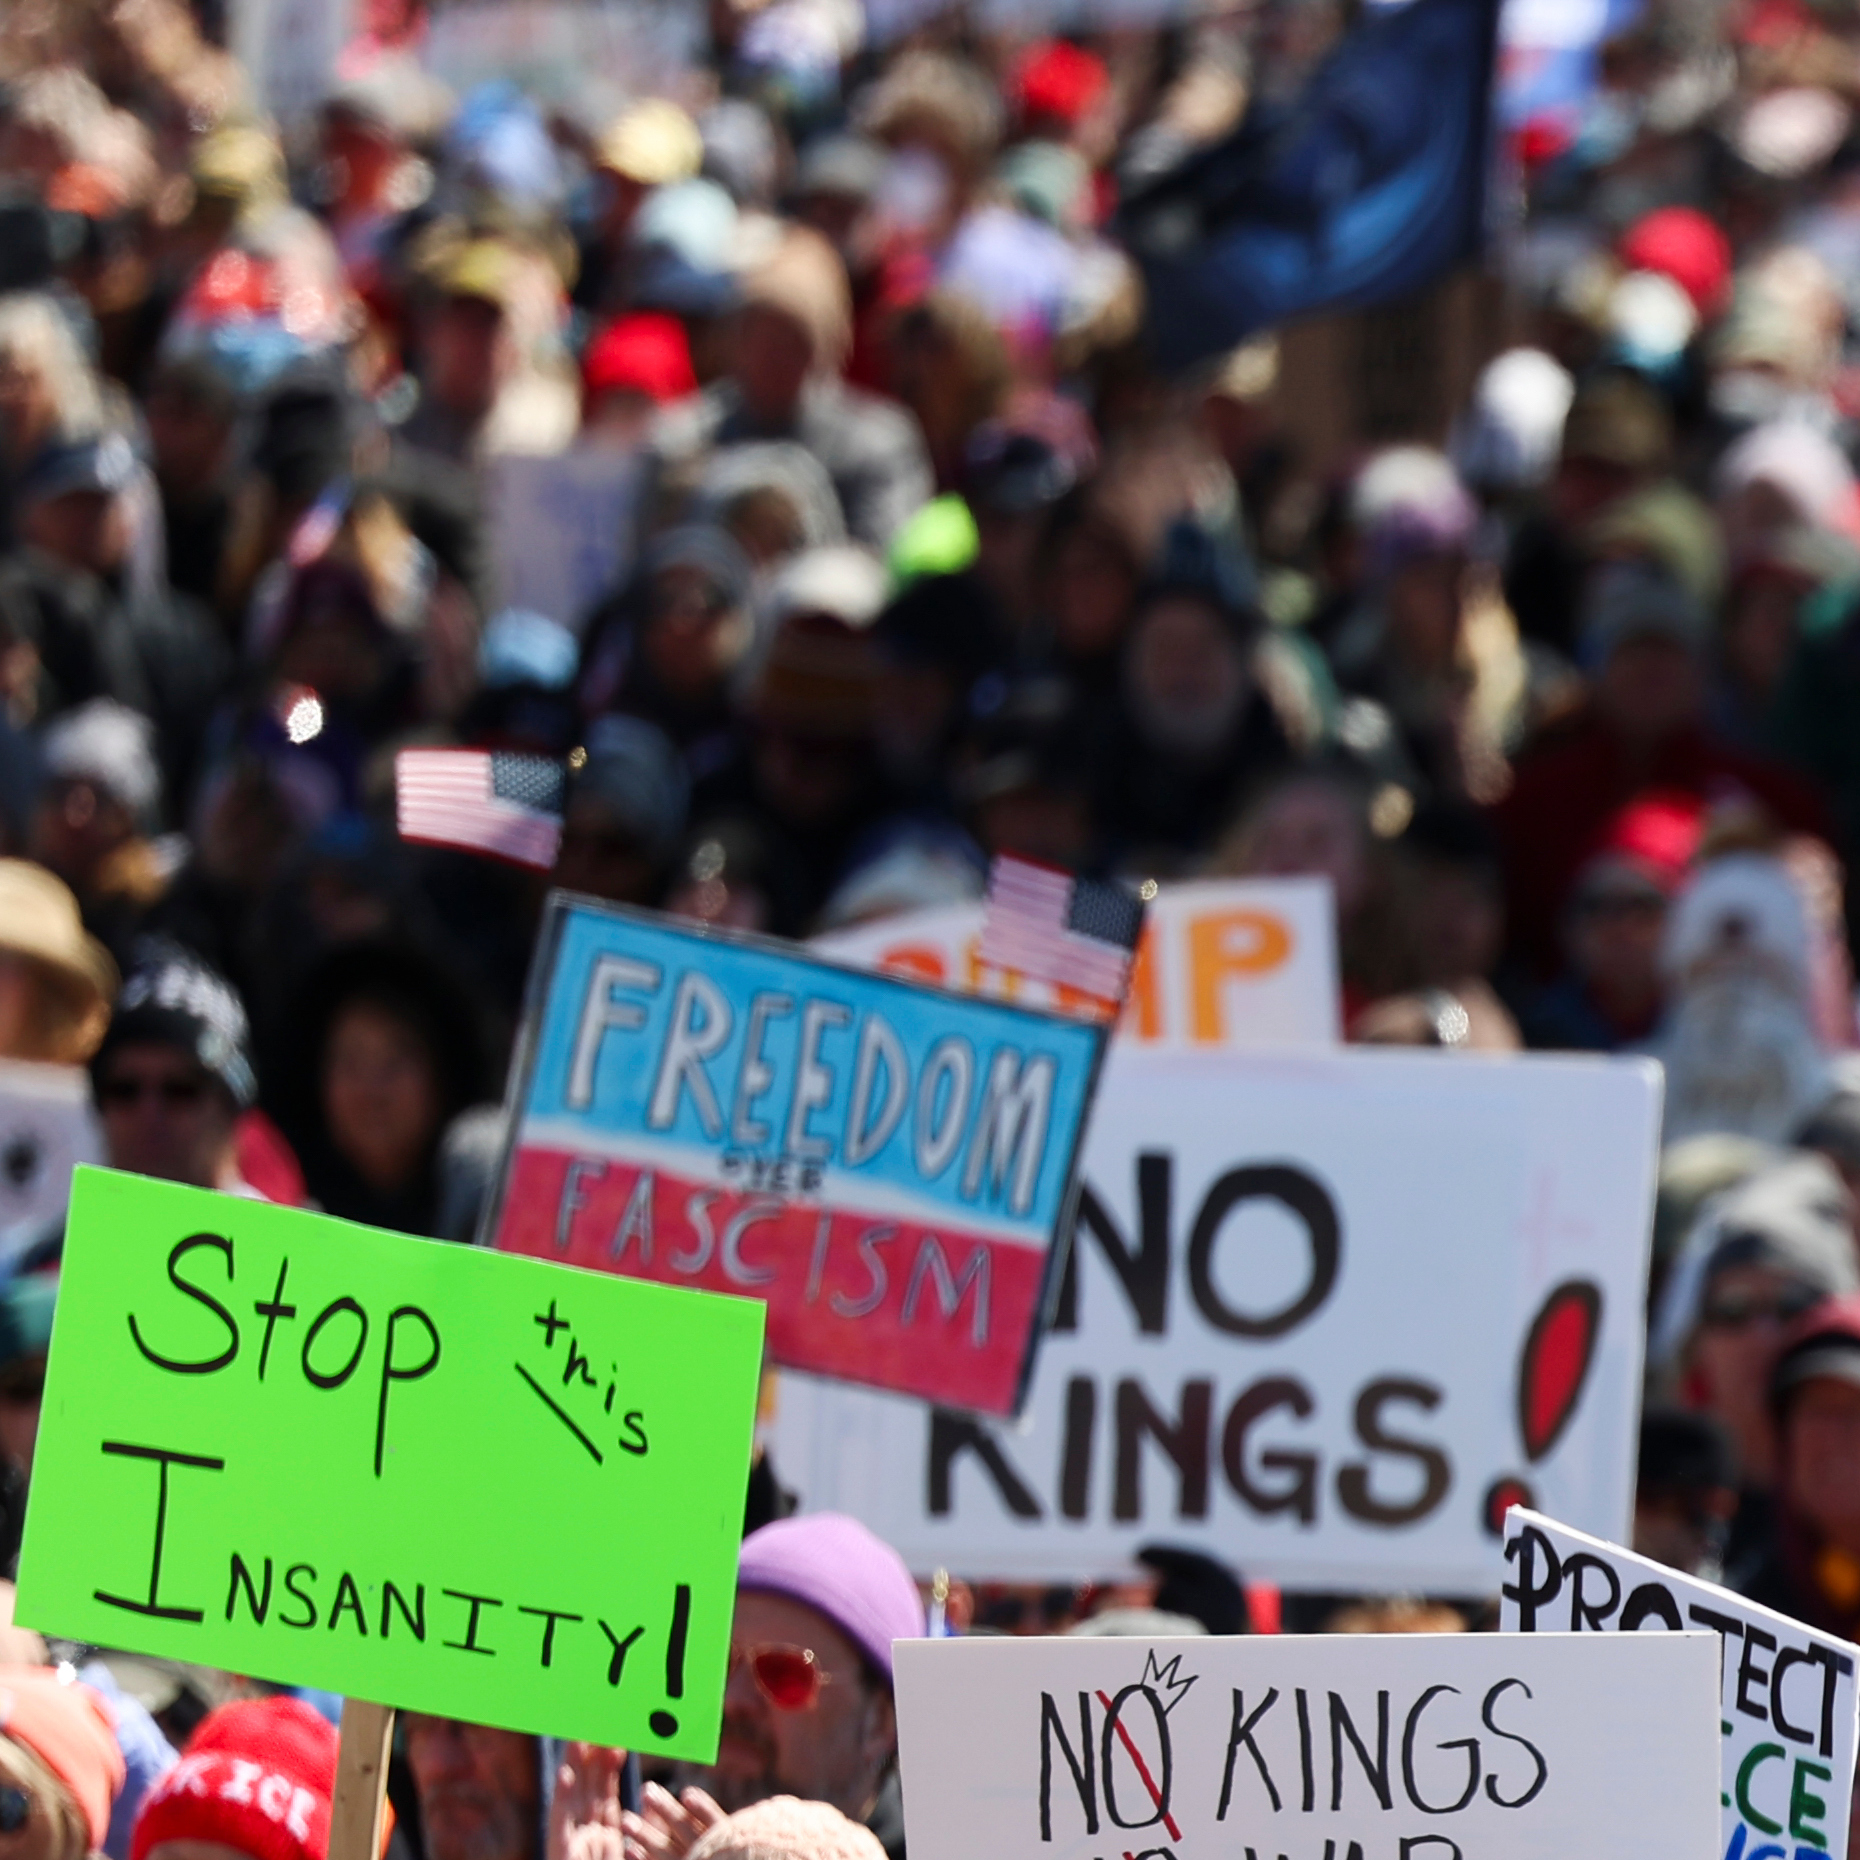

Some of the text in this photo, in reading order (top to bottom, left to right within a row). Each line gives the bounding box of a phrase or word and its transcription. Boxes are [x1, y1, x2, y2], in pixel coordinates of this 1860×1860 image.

[565, 953, 1060, 1217] FREEDOM
[128, 1232, 441, 1477] Stop
[555, 1157, 992, 1348] FASCISM
[1050, 1151, 1342, 1341] NO
[93, 1440, 691, 1739] INSANITY!
[1040, 1683, 1182, 1842] NO
[1217, 1677, 1548, 1821] KINGS
